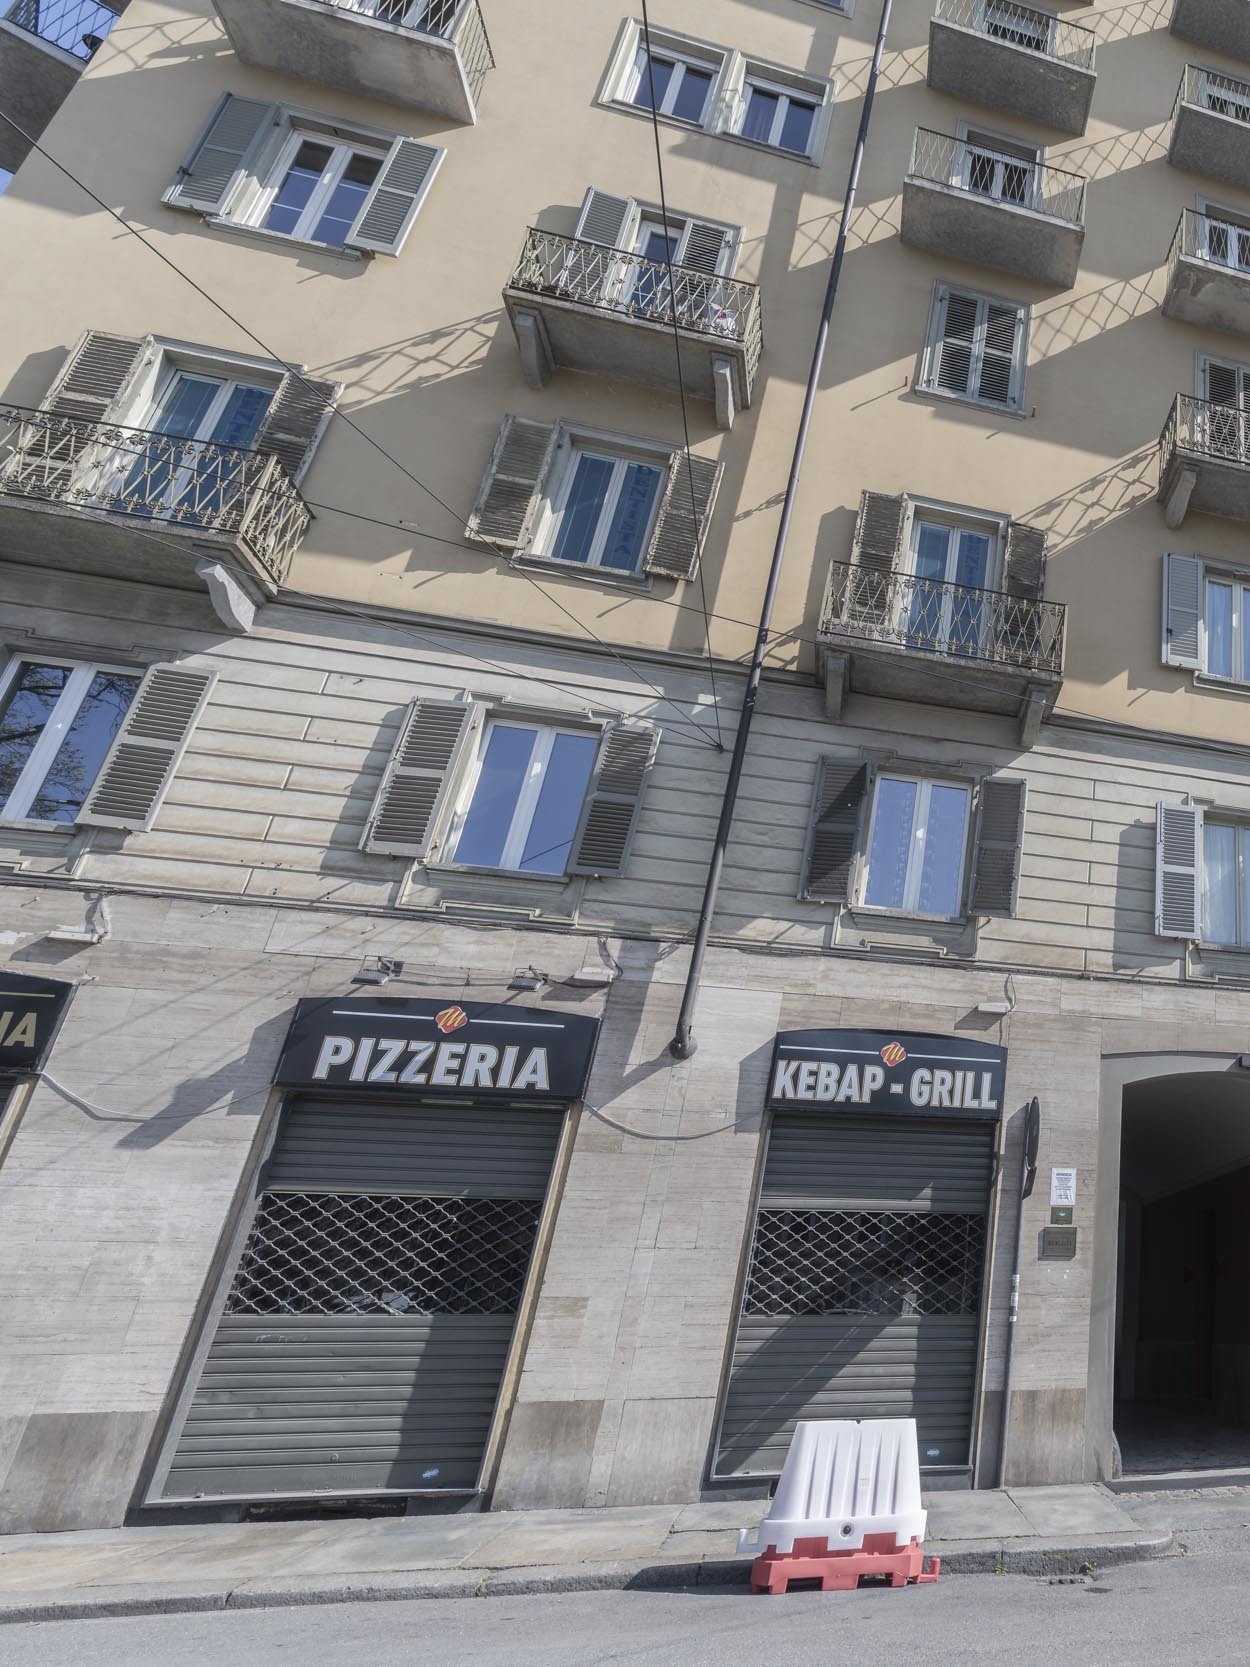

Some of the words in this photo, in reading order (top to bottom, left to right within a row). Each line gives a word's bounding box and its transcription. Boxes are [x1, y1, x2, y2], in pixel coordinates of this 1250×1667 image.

[312, 1035, 550, 1091] PIZZERIA
[772, 1059, 885, 1104] KEBAP
[909, 1067, 998, 1110] GRILL
